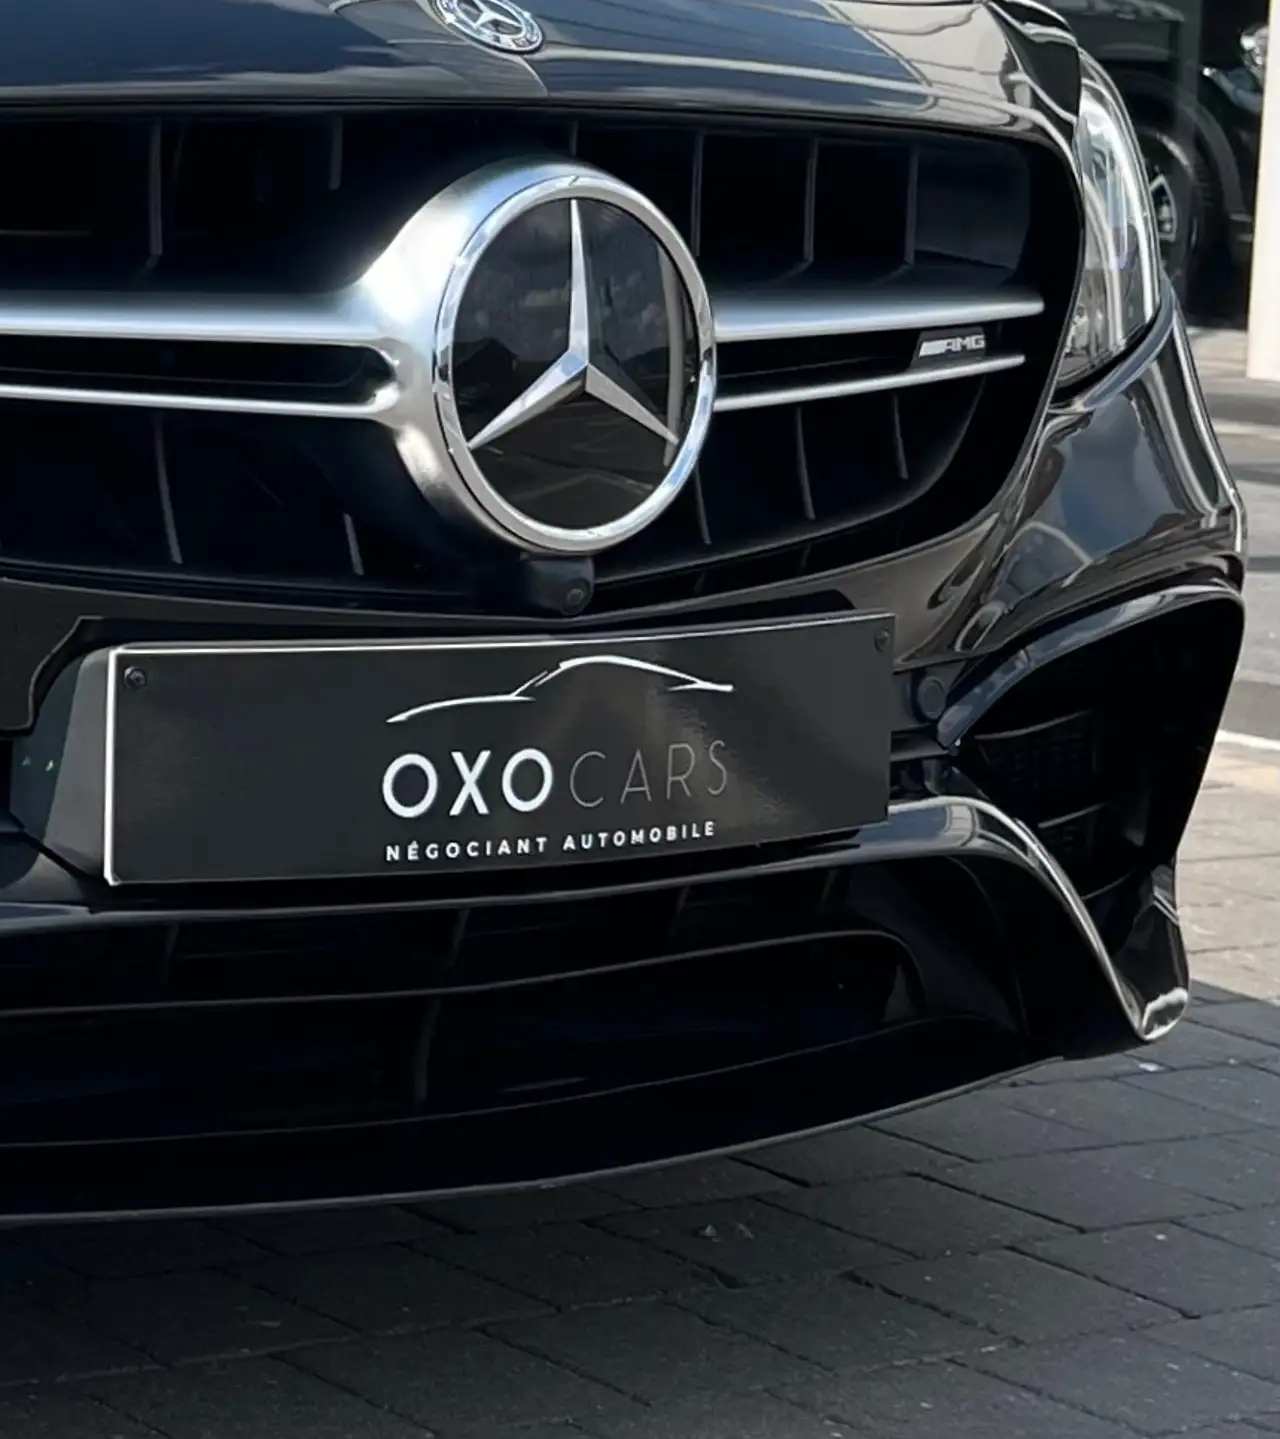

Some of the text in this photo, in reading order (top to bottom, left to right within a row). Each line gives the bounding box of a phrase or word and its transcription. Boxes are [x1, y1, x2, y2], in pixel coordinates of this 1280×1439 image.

[943, 334, 986, 353] AMG
[382, 740, 728, 818] OXO CARS
[385, 821, 716, 861] NÉGOCIANT AUTOMOBILE
